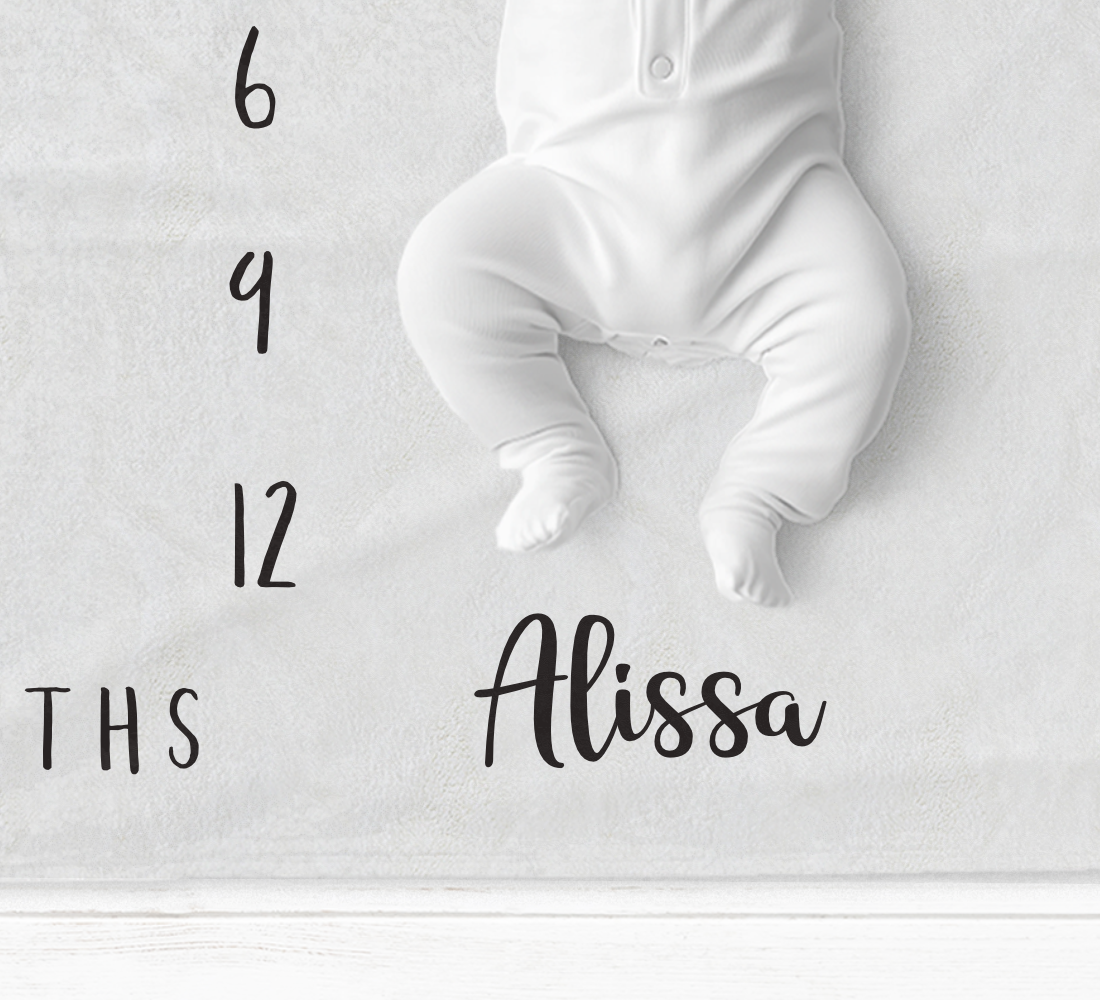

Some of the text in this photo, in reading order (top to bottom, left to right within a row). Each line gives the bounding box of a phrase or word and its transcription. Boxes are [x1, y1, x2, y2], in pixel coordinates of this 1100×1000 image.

[233, 24, 277, 130] 6
[228, 249, 275, 356] 9
[233, 479, 298, 589] 12
[472, 612, 828, 770] Alissa
